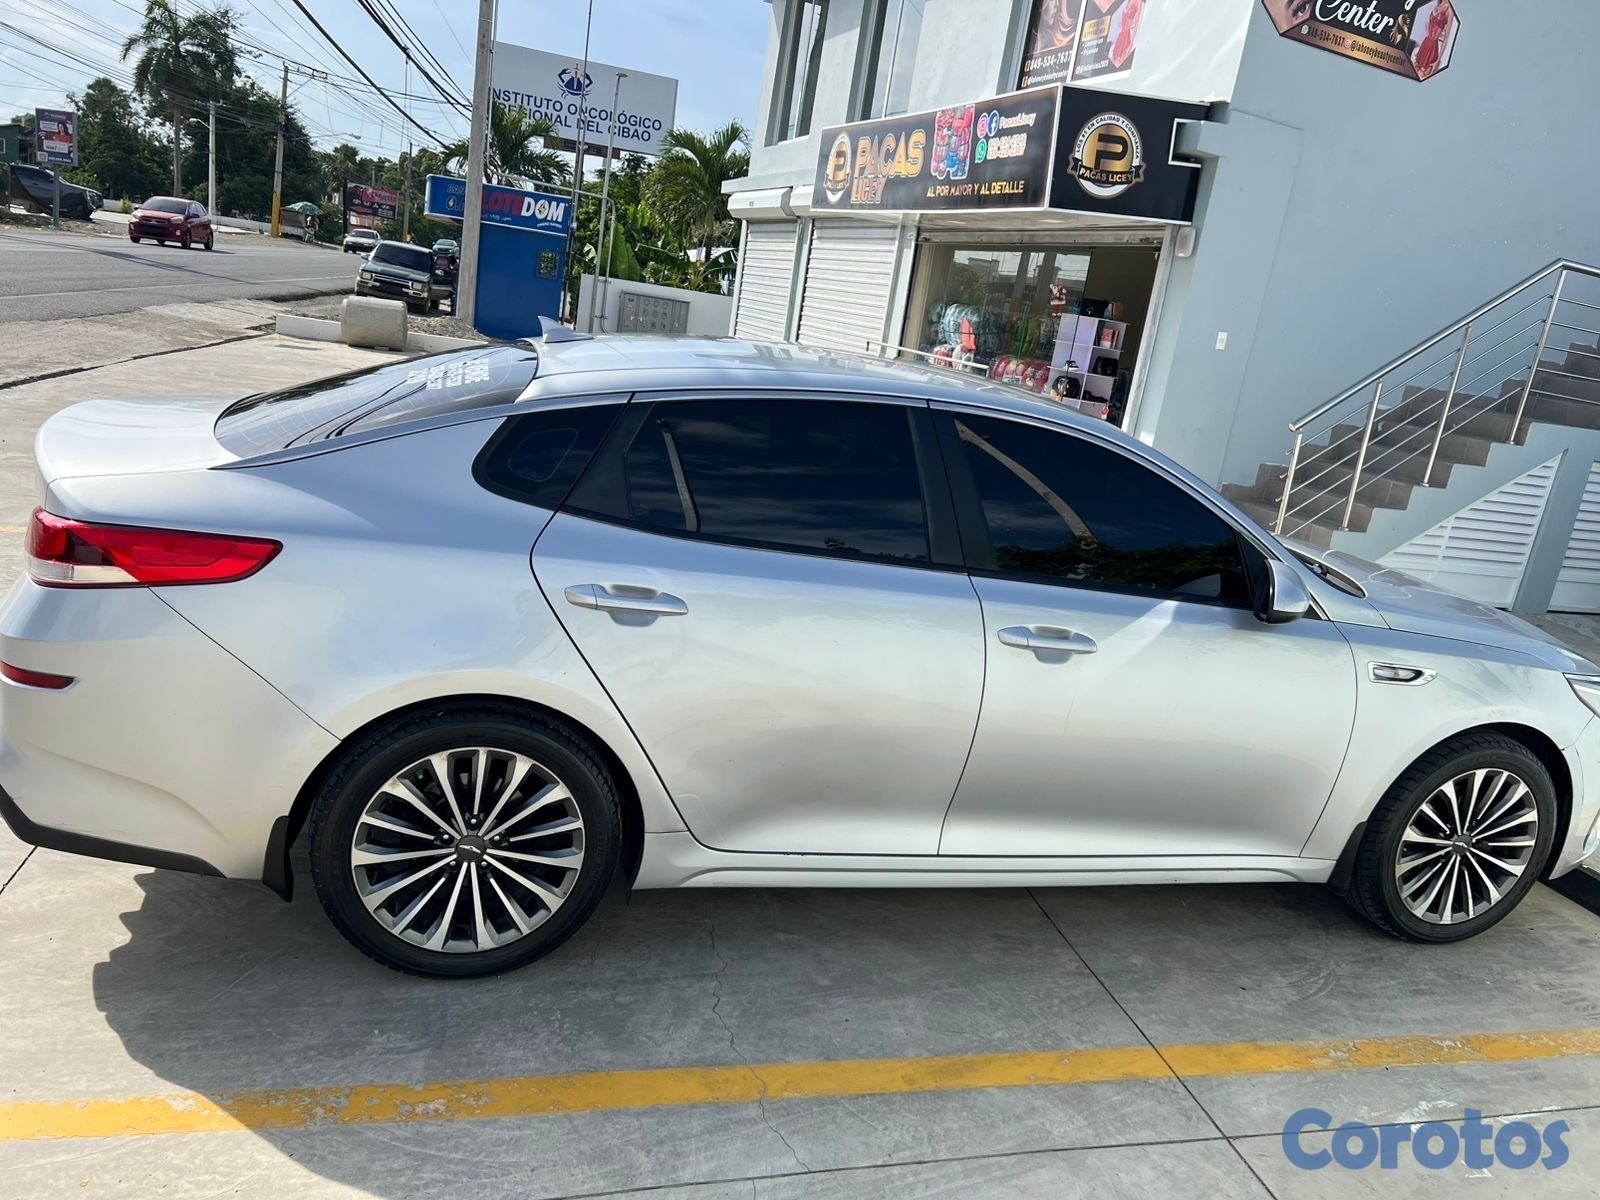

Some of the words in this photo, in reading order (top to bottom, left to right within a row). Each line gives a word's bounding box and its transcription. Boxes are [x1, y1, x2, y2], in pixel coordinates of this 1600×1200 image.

[1315, 0, 1394, 35] Center
[567, 102, 662, 131] ONCOLÓGICO
[1087, 122, 1095, 131] EN
[1095, 115, 1121, 125] CALIDAD
[576, 118, 603, 134] DEL
[607, 125, 651, 142] CIBAO
[854, 129, 927, 179] PACAS
[1079, 167, 1107, 181] PACAS
[1108, 173, 1134, 183] LICEY
[850, 174, 888, 204] LICEY
[927, 186, 936, 197] AL
[936, 184, 949, 197] POR
[949, 183, 974, 196] MAYOR
[973, 183, 980, 195] Y
[980, 182, 990, 195] AL
[991, 180, 1025, 195] DETALLE
